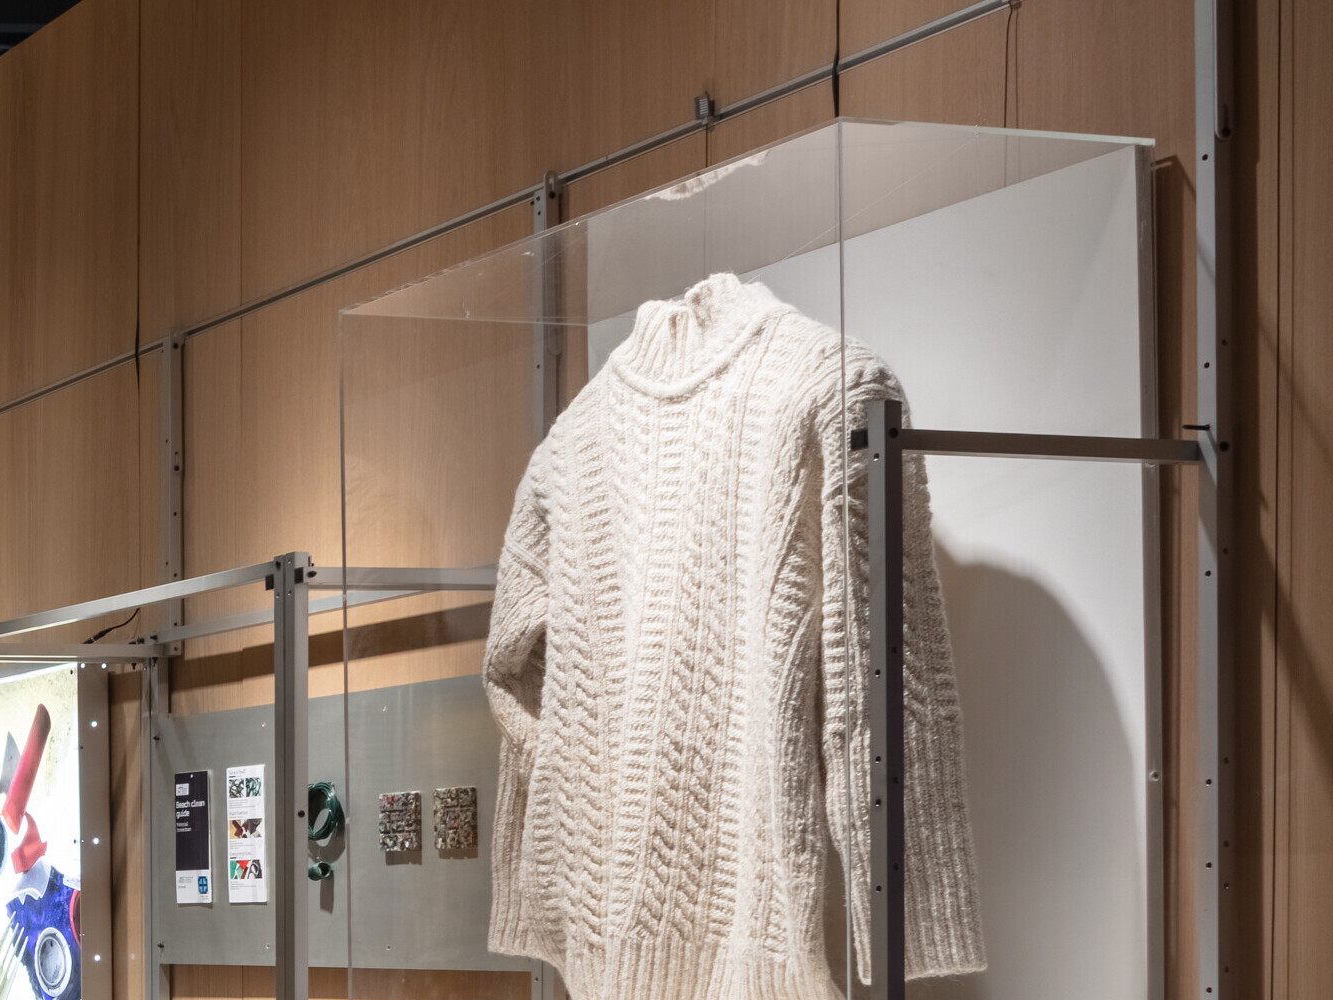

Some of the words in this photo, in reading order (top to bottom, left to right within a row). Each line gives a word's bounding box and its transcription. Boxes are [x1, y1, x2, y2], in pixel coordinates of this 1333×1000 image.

[176, 800, 190, 808] Beach
[191, 800, 205, 808] clean
[176, 810, 190, 819] guide
